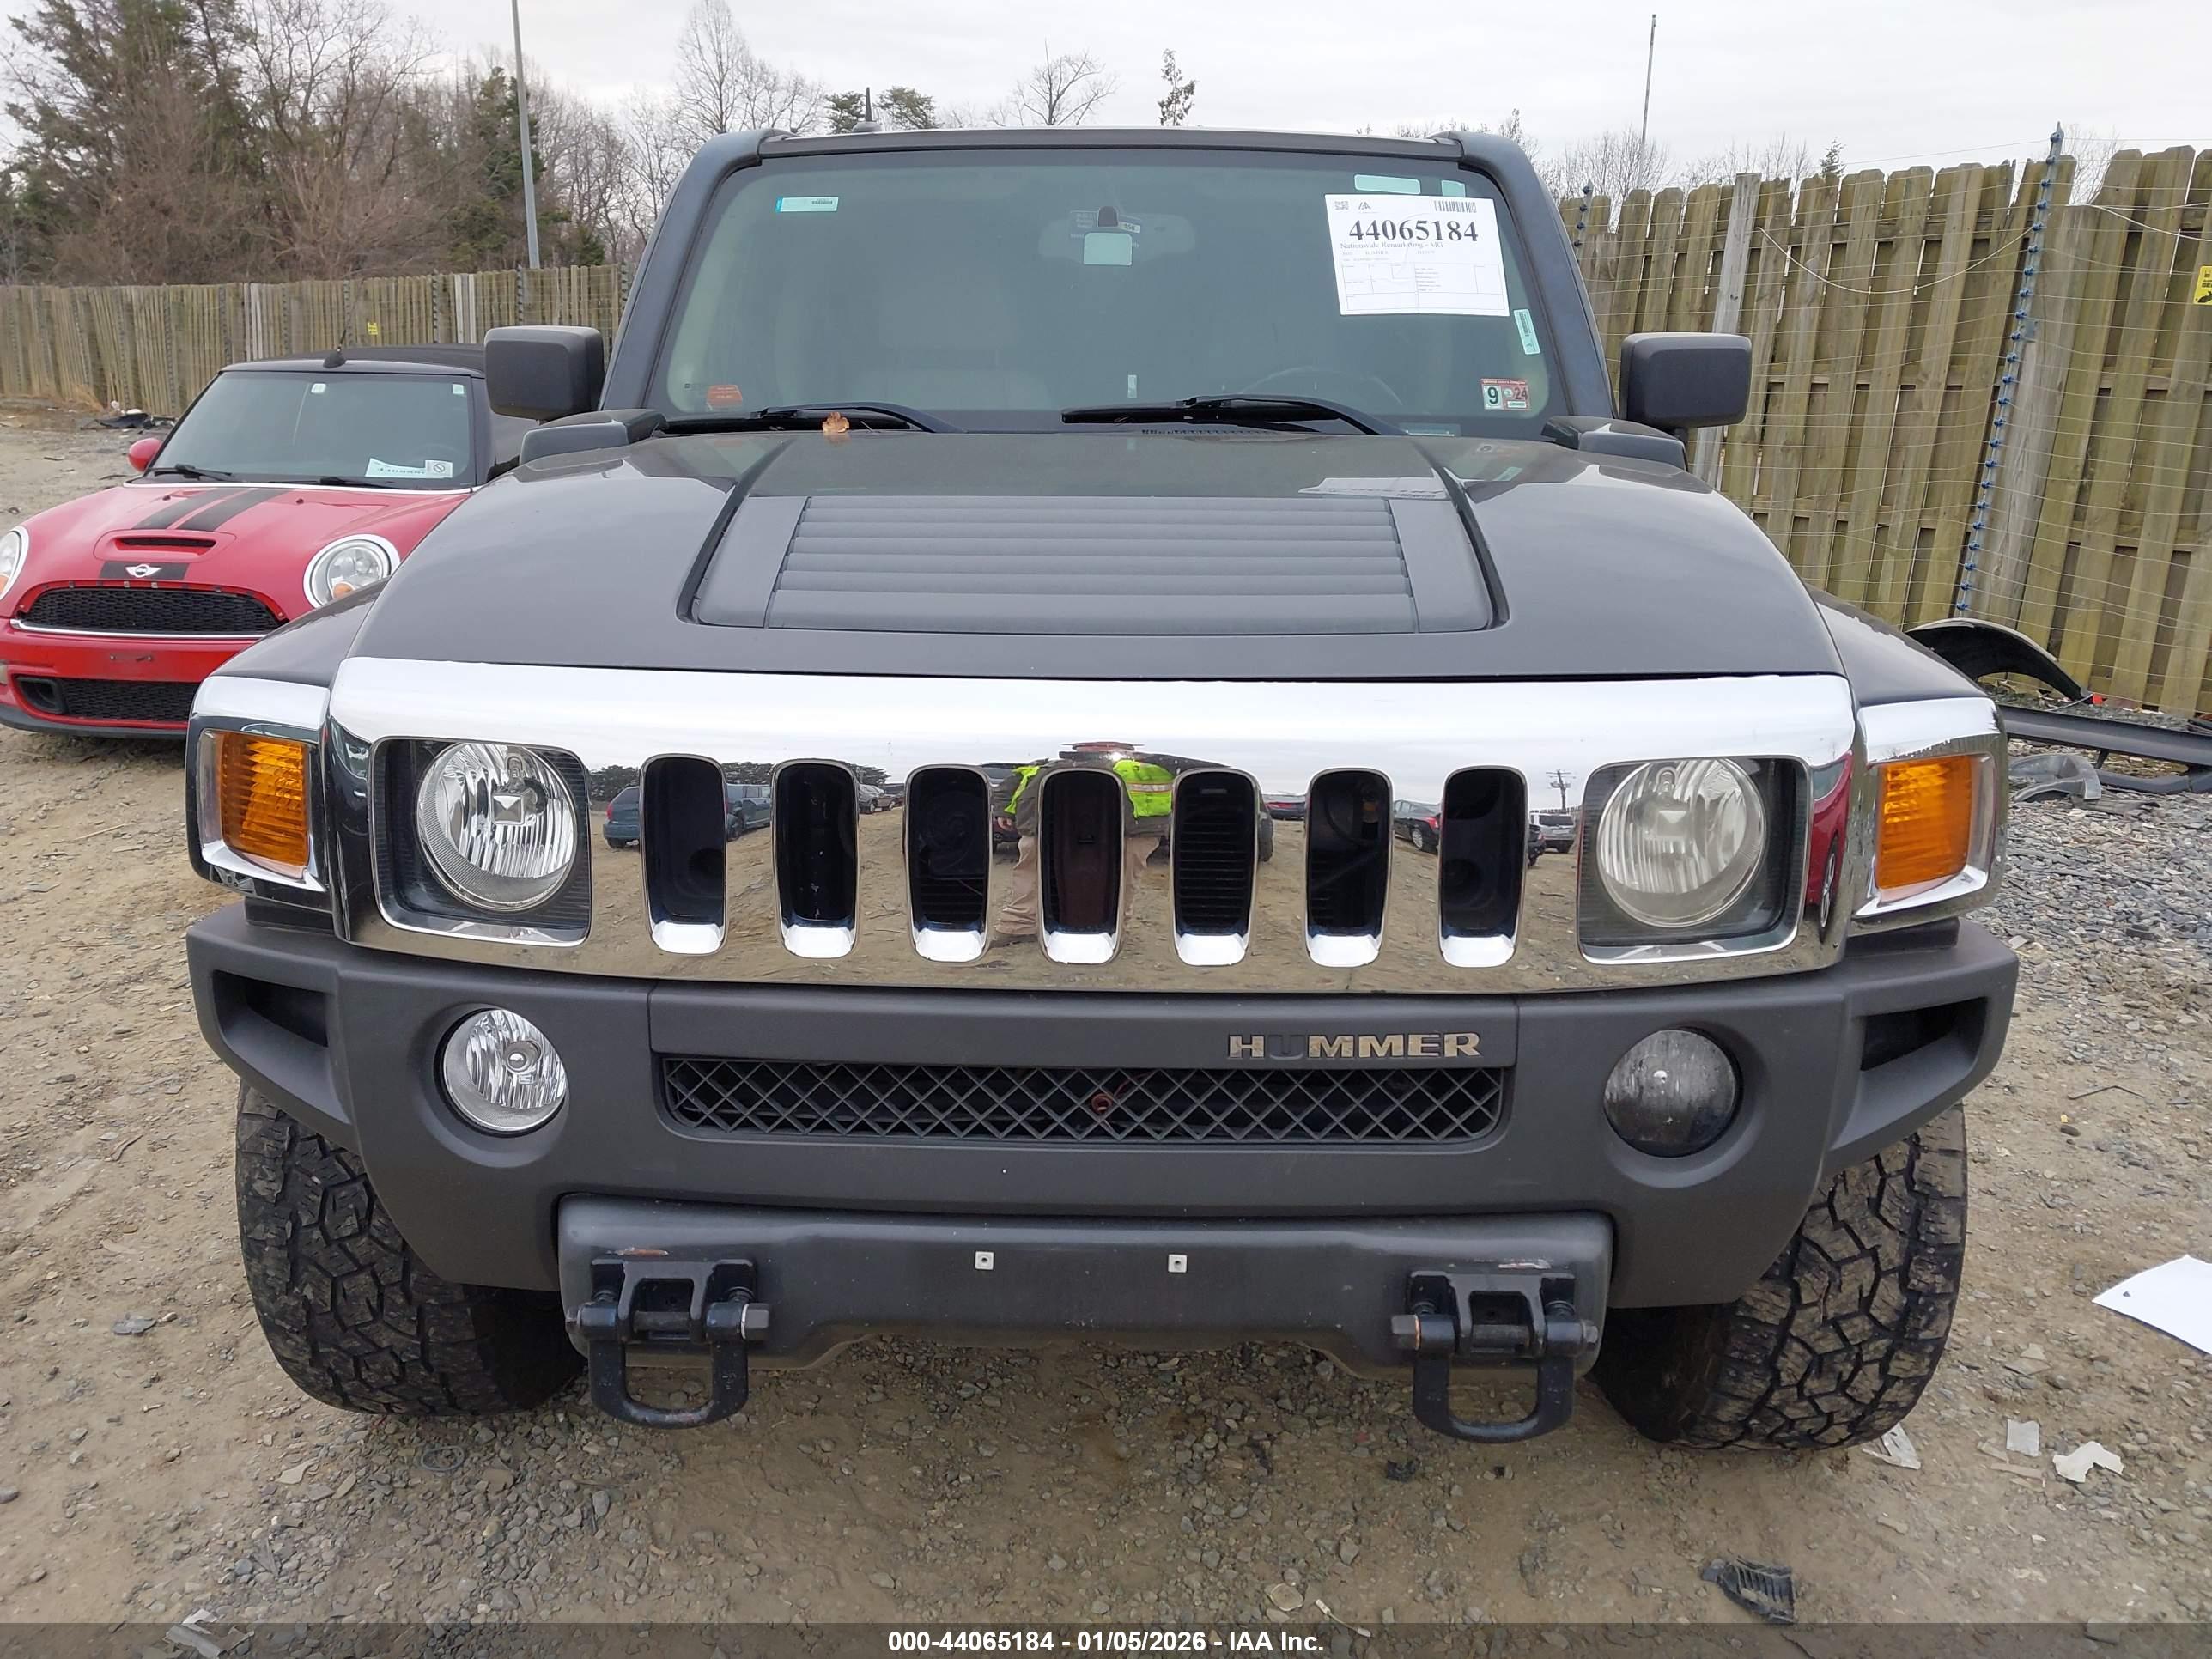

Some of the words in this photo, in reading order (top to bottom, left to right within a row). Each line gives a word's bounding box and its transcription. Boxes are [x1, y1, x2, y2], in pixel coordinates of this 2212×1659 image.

[1349, 219, 1479, 241] 44065184
[1487, 386, 1499, 404] 9
[1228, 1033, 1481, 1060] HUMMER
